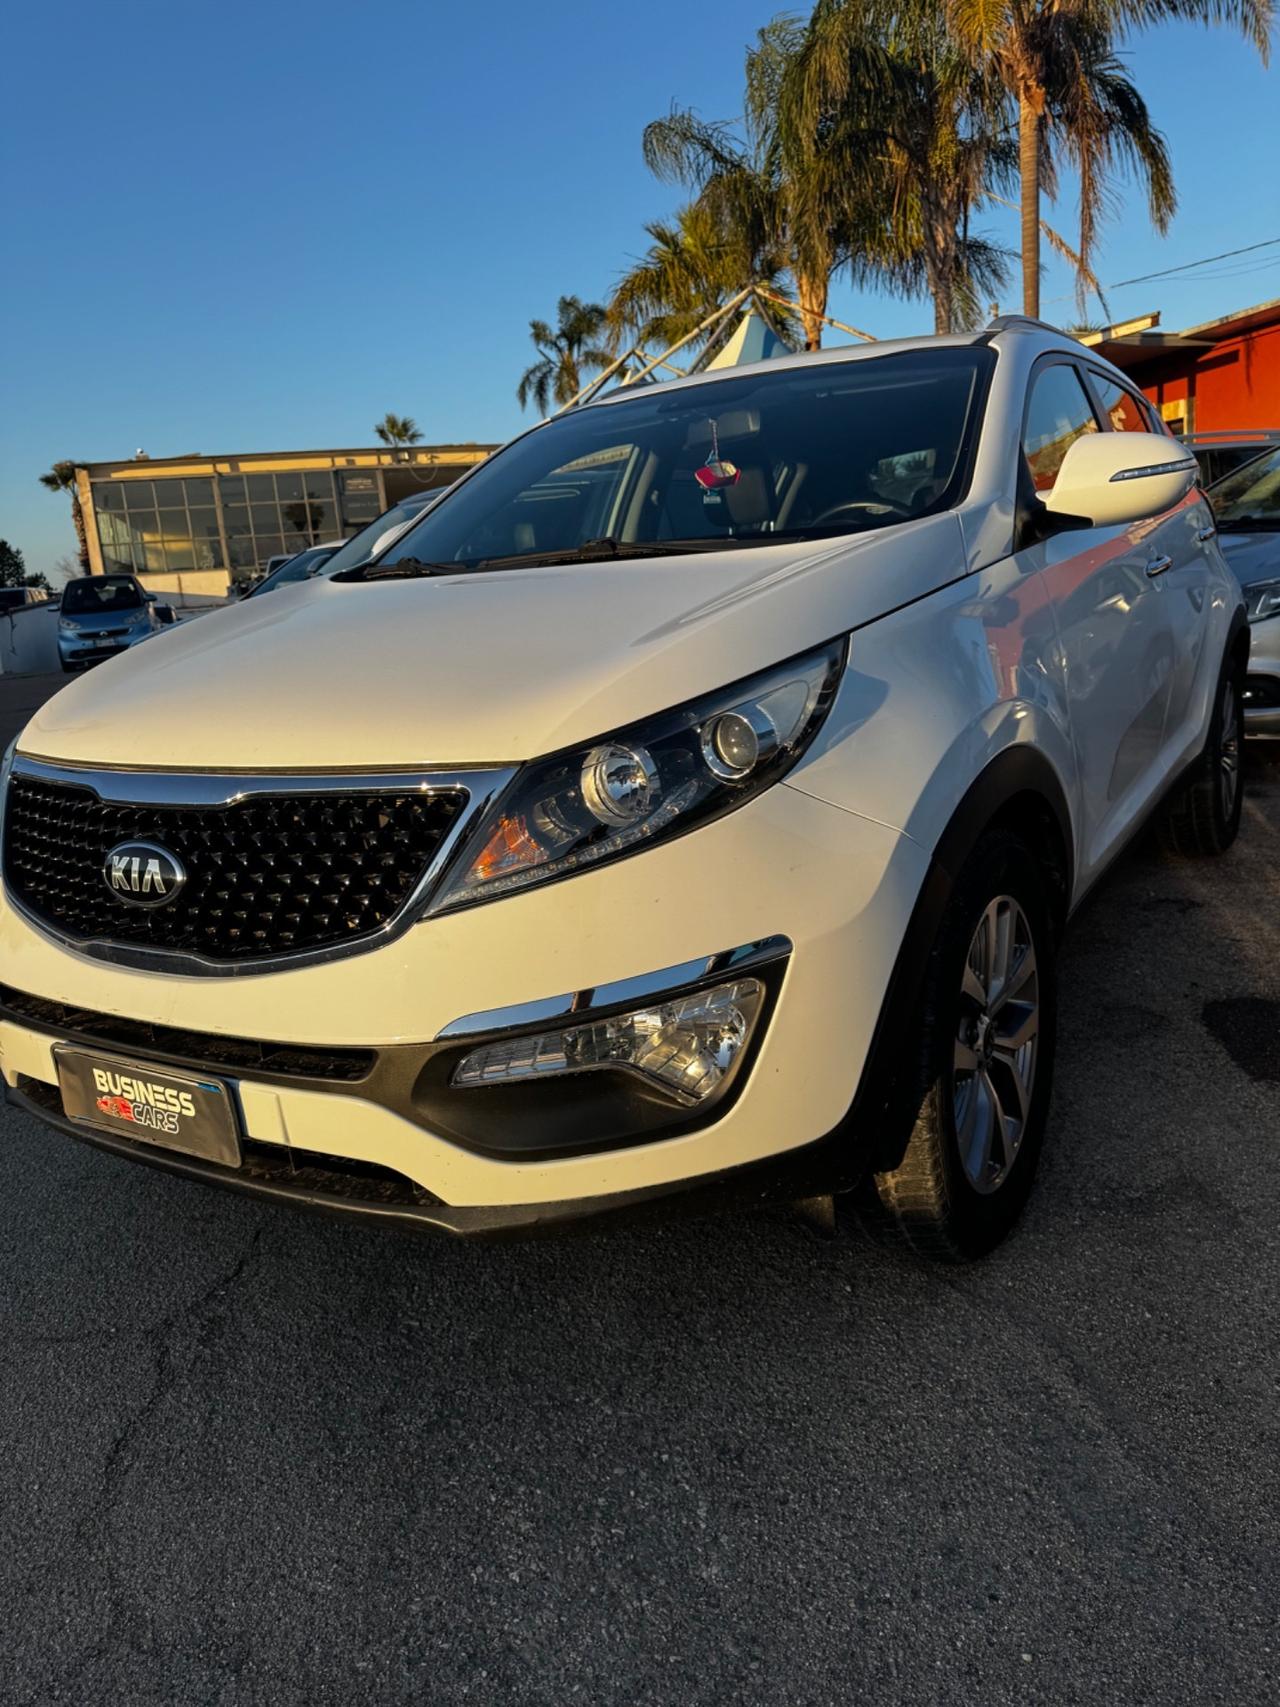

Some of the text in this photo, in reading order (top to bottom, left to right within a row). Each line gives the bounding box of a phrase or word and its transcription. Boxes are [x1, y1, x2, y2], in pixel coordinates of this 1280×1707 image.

[111, 855, 166, 893] KIA
[92, 1068, 196, 1117] BUSINESS
[132, 1102, 179, 1134] CARS
